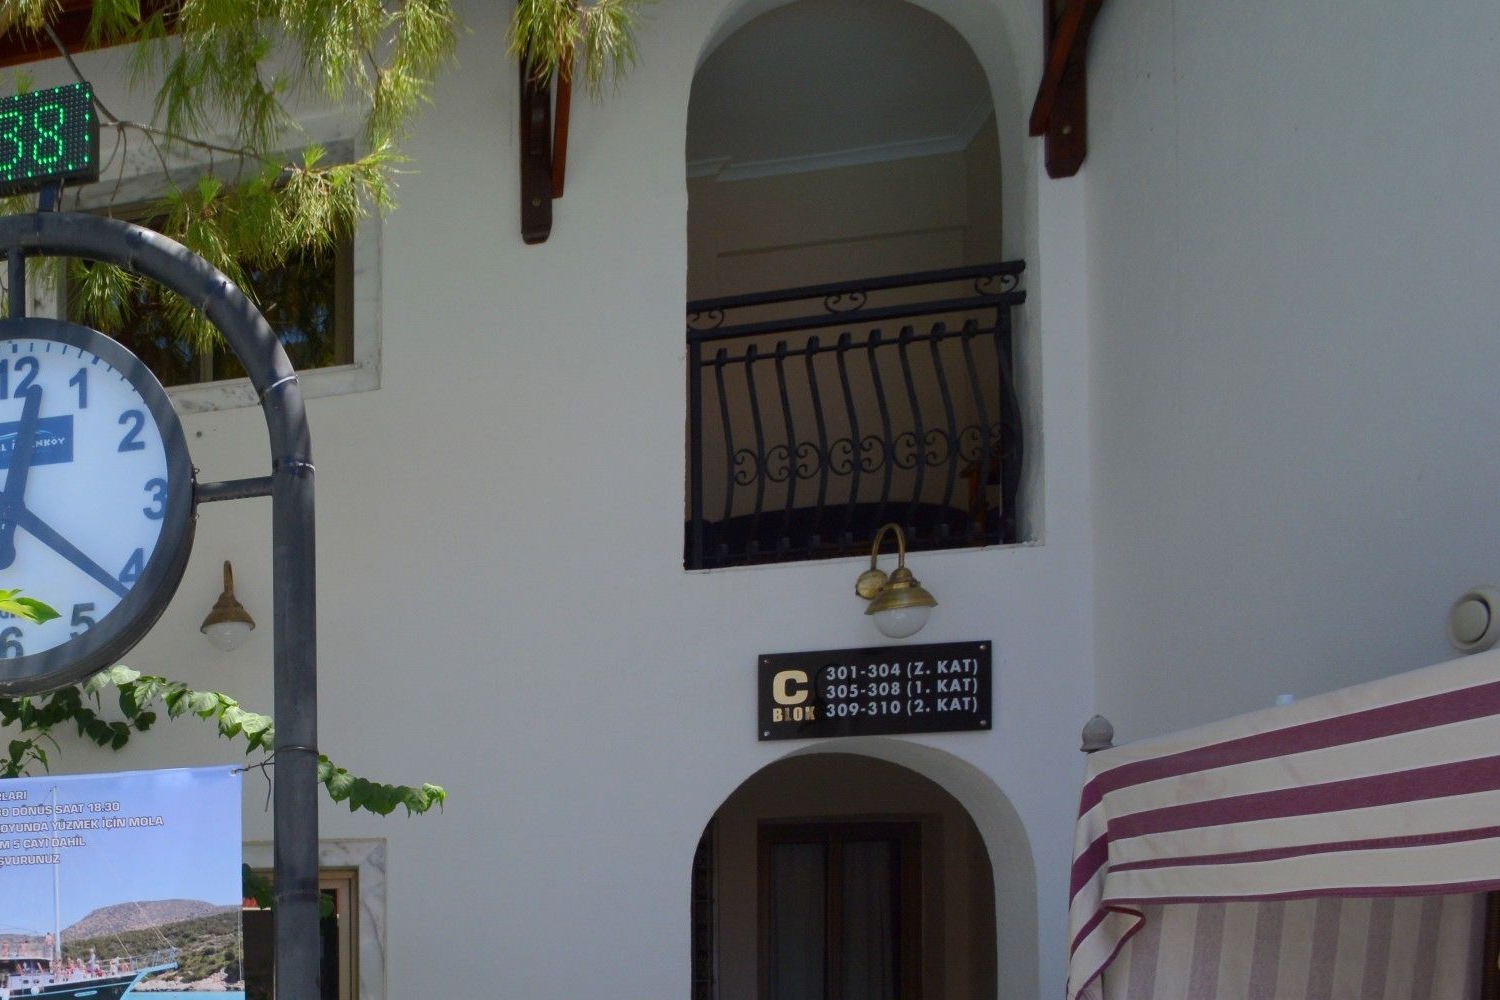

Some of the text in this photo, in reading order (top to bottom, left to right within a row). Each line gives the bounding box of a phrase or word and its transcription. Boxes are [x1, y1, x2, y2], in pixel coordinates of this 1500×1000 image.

[69, 368, 88, 408] 1
[117, 410, 145, 452] 2
[143, 478, 167, 520] 3
[118, 548, 144, 583] 4
[70, 602, 96, 638] 5
[826, 663, 901, 681] 301-304
[937, 658, 979, 675] KAT)
[772, 670, 808, 705] C
[826, 678, 979, 699] 305-308 (1. KAT)
[772, 706, 816, 723] BLOK
[826, 697, 979, 718] 309-310 (2. KAT)
[55, 803, 85, 814] SAAT
[87, 801, 120, 812] 18.30
[51, 818, 99, 831] YÜZMEK
[129, 816, 164, 827] MOLA
[13, 839, 21, 849] 5
